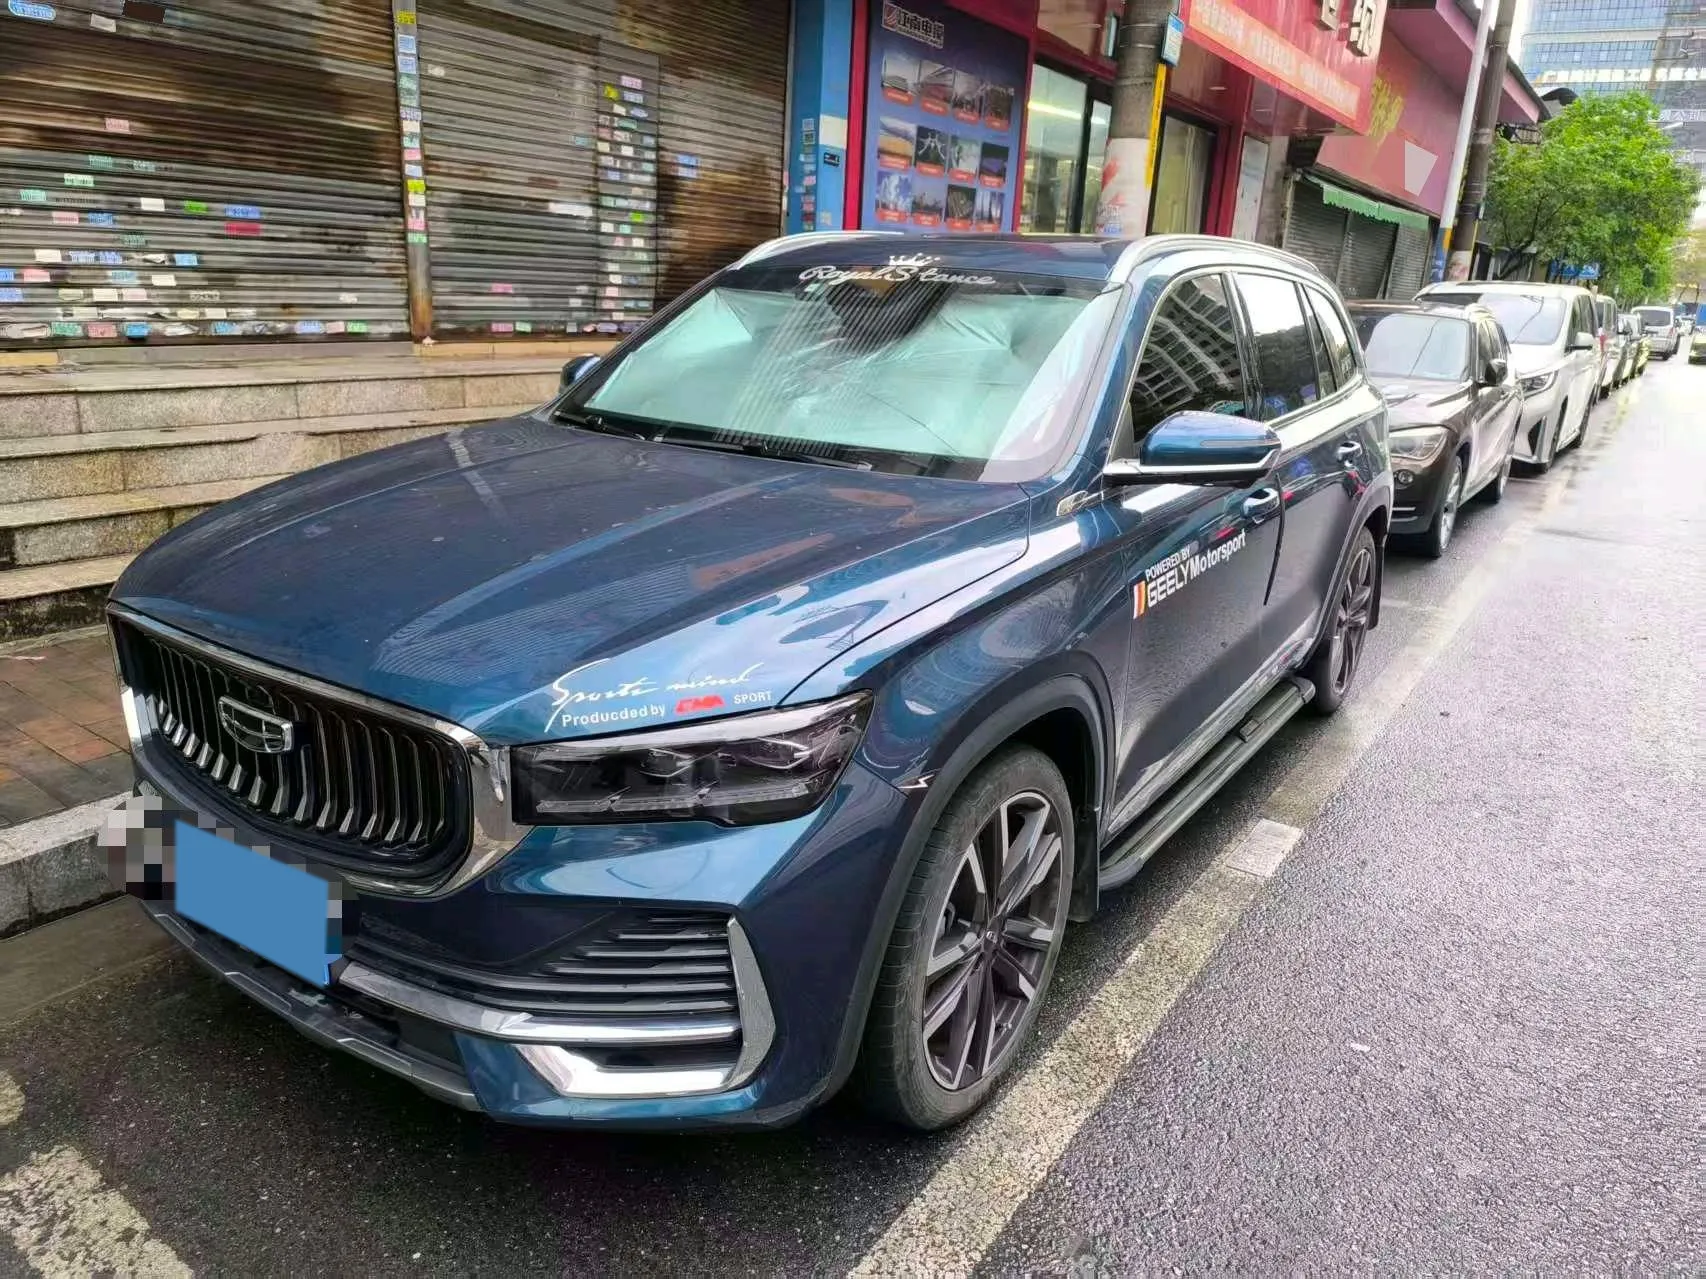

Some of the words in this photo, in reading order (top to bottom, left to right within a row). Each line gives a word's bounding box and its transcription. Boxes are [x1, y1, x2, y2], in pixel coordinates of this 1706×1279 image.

[799, 265, 889, 286] Royal
[884, 266, 997, 285] Stance
[1145, 553, 1181, 582] POWERED
[1181, 543, 1192, 562] BY
[562, 705, 649, 728] Producded
[650, 704, 666, 719] by
[733, 690, 773, 705] SPORT
